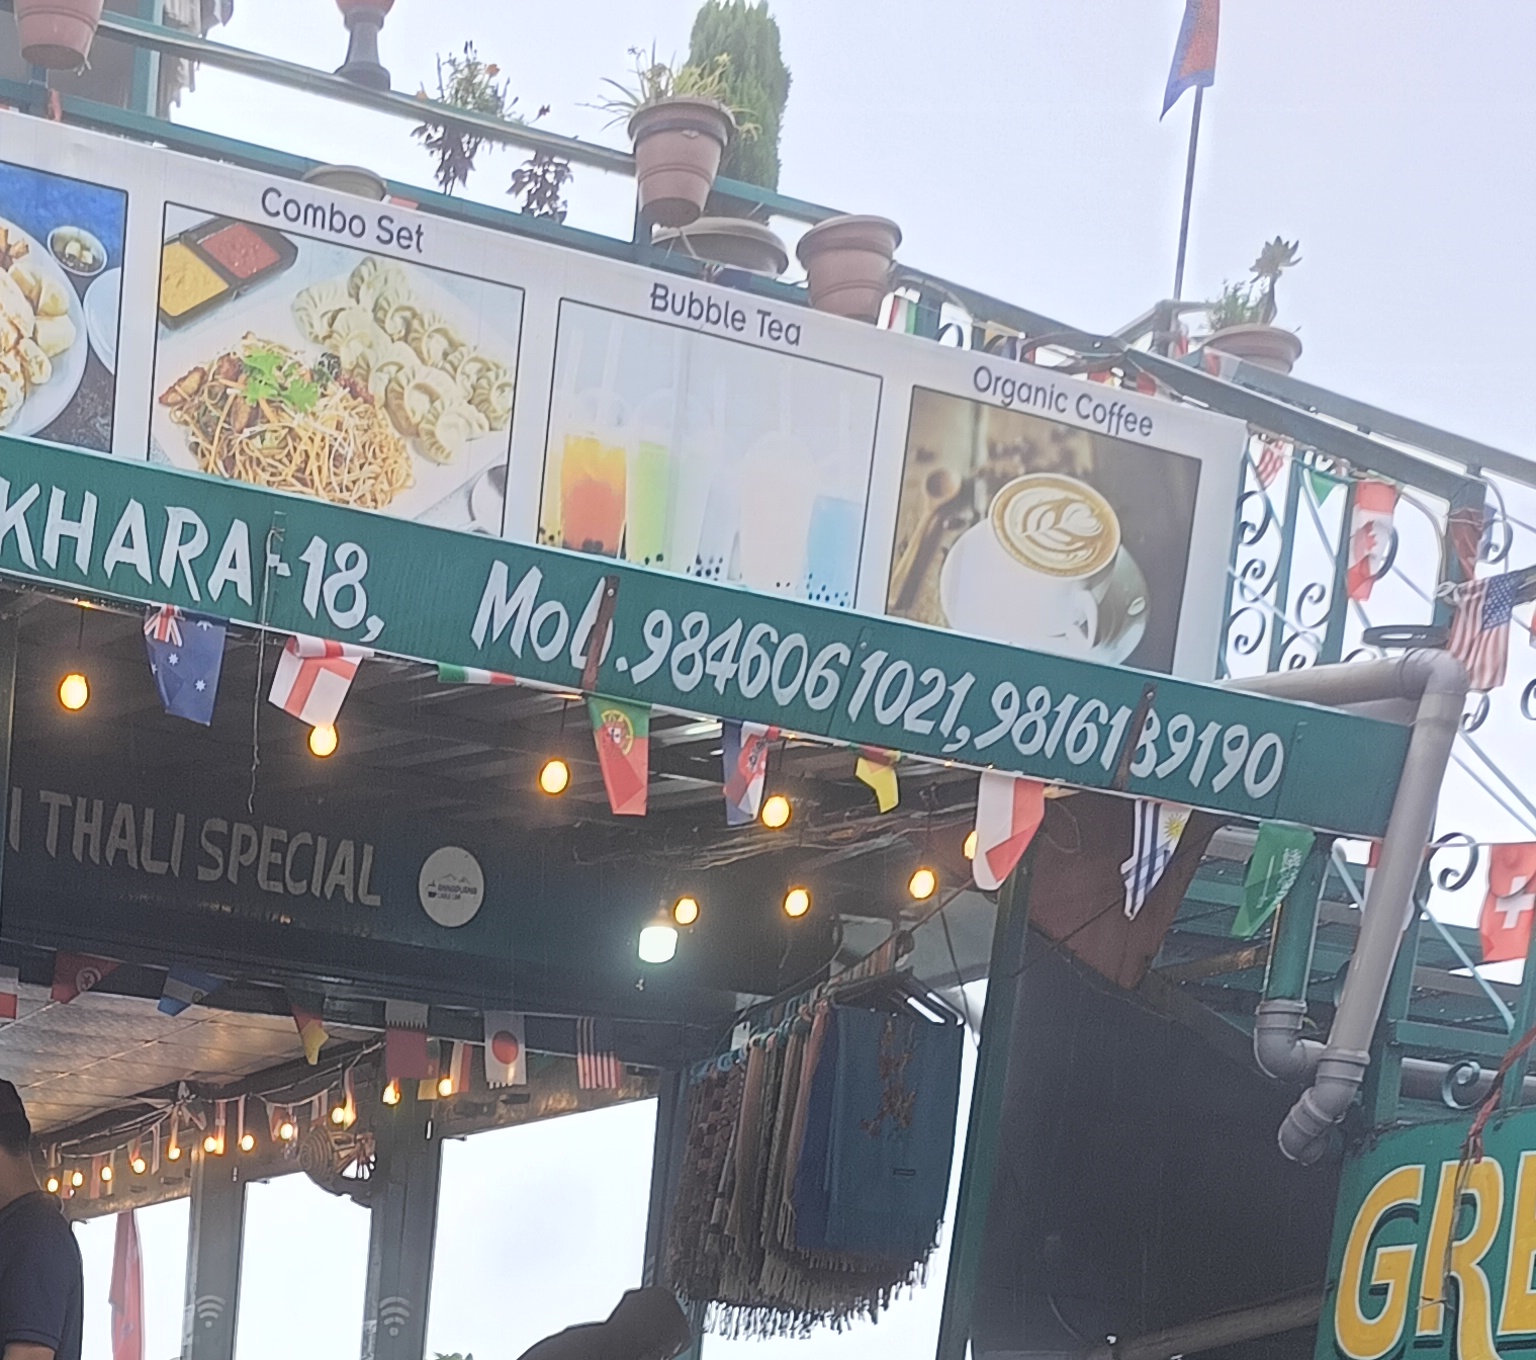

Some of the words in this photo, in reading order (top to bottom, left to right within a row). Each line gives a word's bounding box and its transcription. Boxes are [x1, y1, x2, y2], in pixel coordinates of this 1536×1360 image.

[261, 187, 366, 239] Combo
[376, 214, 425, 253] Set
[650, 282, 746, 332] Bubble
[756, 308, 802, 347] Tea
[973, 365, 1068, 413] Organic
[1075, 392, 1154, 437] Coffee
[39, 789, 185, 877] THALI
[197, 817, 381, 907] SPECIAL
